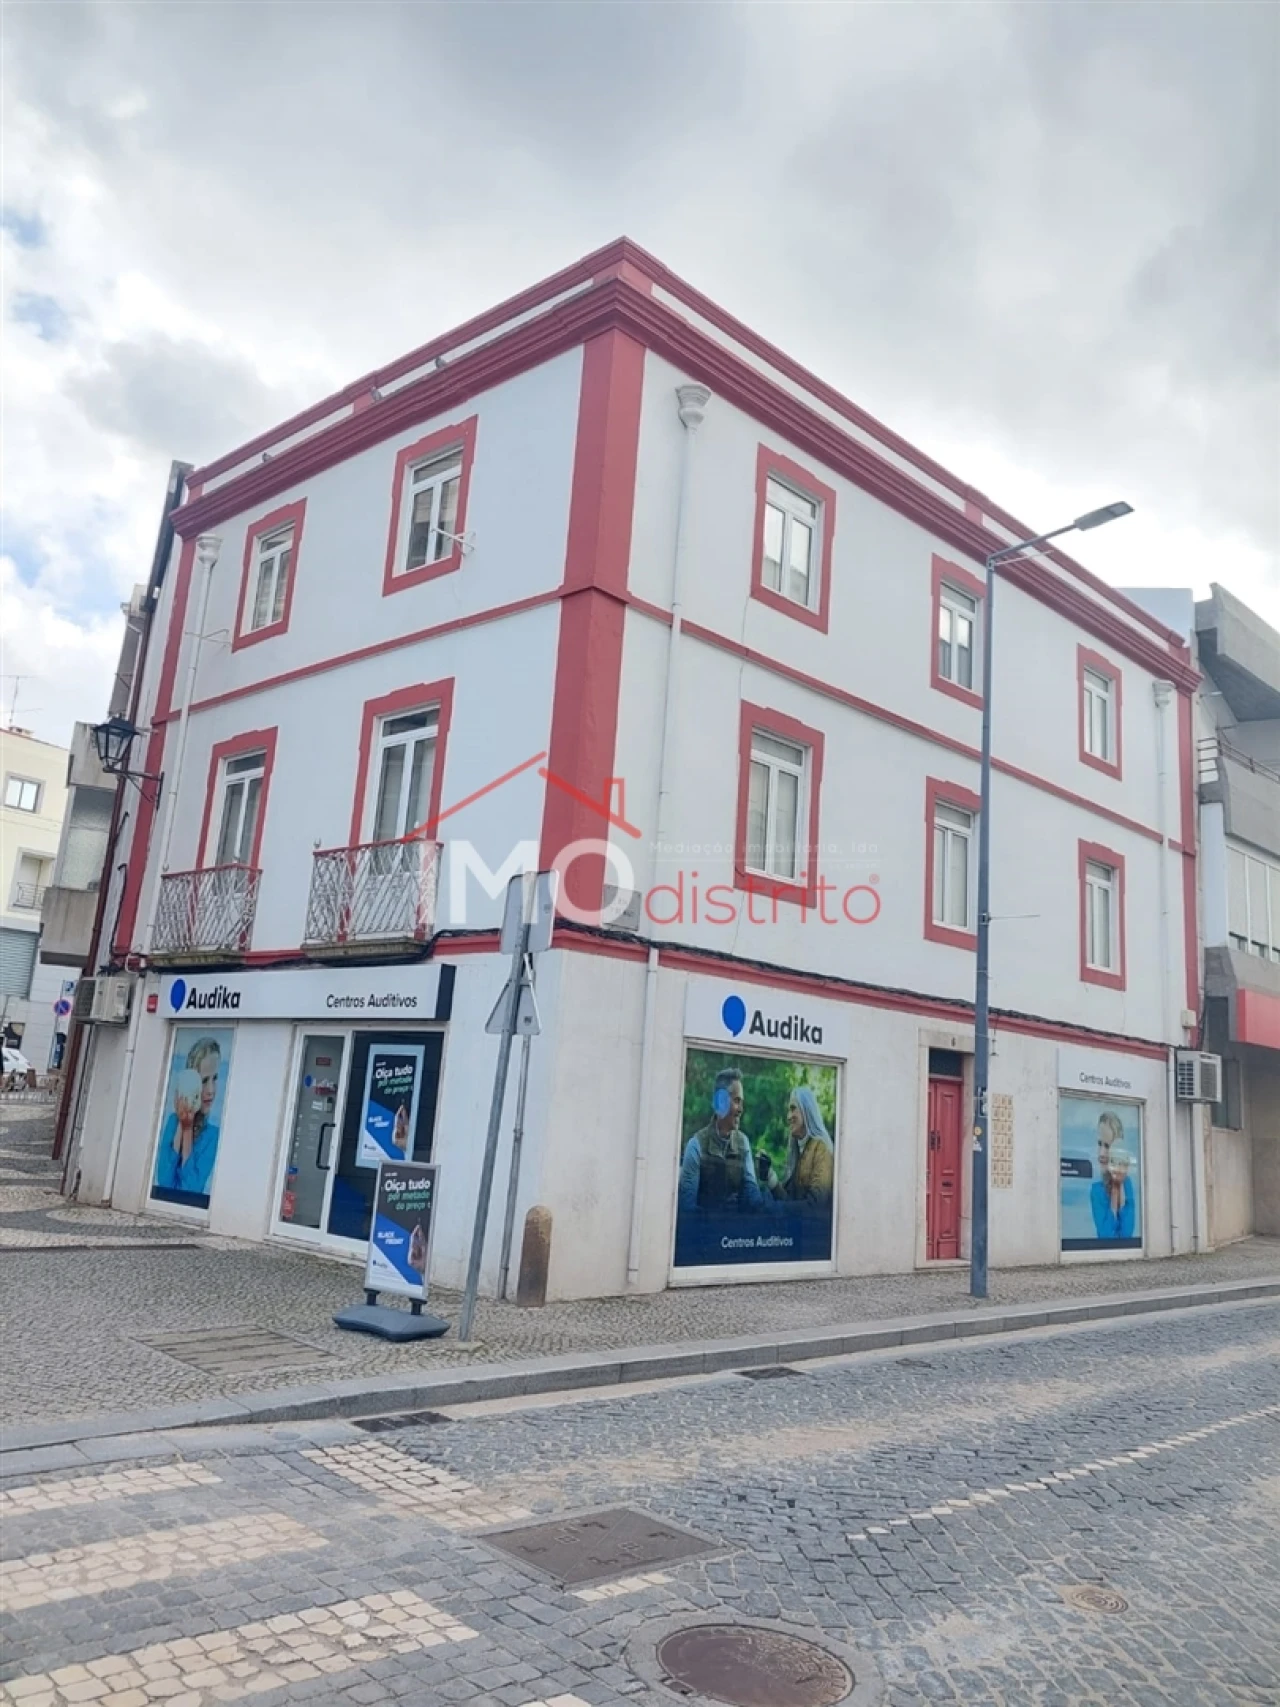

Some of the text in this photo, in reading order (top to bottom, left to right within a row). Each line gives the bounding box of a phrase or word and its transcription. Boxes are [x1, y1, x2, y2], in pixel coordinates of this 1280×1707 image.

[186, 985, 241, 1009] Audika
[326, 993, 418, 1008] Centros Auditivos
[749, 1009, 823, 1045] Audika
[394, 1064, 413, 1077] tudo
[1079, 1071, 1104, 1086] Centros
[385, 1177, 431, 1193] Oiça tudo
[721, 1235, 794, 1249] Centros Auditivos
